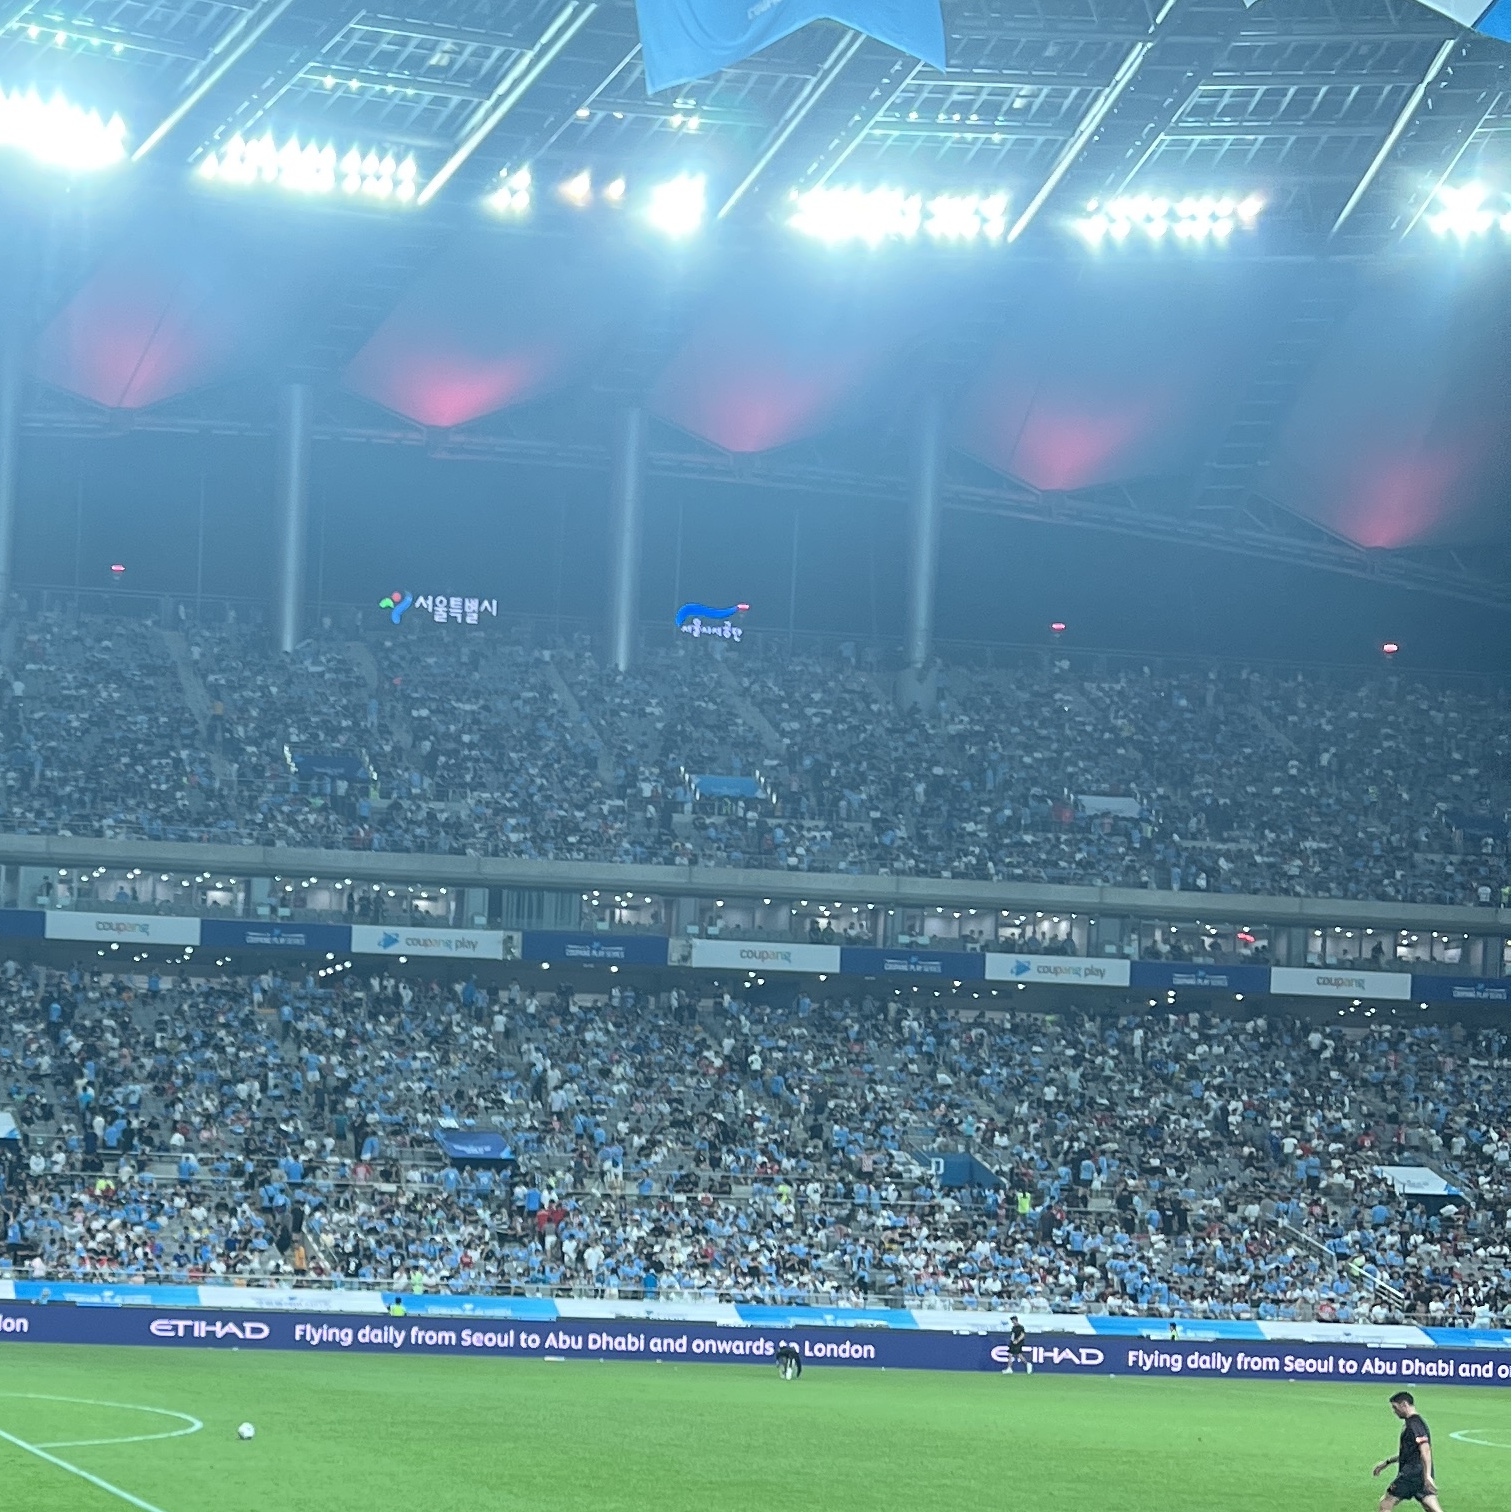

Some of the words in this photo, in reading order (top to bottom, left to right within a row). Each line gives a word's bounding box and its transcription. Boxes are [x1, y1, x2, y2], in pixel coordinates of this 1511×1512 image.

[414, 594, 498, 625] 서울특별시
[95, 920, 150, 937] coupang
[404, 936, 453, 951] coupang
[455, 937, 479, 953] play
[739, 948, 792, 965] coupang
[1036, 963, 1081, 978] coupang
[1084, 964, 1107, 981] play
[1315, 975, 1366, 991] coupang
[149, 1319, 270, 1340] ETIHAD
[294, 1323, 353, 1347] Flying
[357, 1324, 406, 1349] daily
[410, 1326, 457, 1346] from
[460, 1328, 515, 1348] Seoul
[519, 1330, 541, 1349] to
[544, 1330, 583, 1350] Abu
[587, 1332, 645, 1352] Dhabi
[649, 1334, 688, 1353] and
[691, 1337, 775, 1356] onwards
[804, 1340, 875, 1359] London
[1128, 1349, 1183, 1372] Flying
[1186, 1351, 1233, 1374] daily
[1236, 1352, 1280, 1372] from
[1283, 1355, 1334, 1373] Seoul
[1337, 1357, 1358, 1374] to
[1360, 1357, 1398, 1375] Abu
[1401, 1358, 1455, 1377] Dhabi
[1458, 1360, 1494, 1378] and
[1497, 1364, 1511, 1379] o
